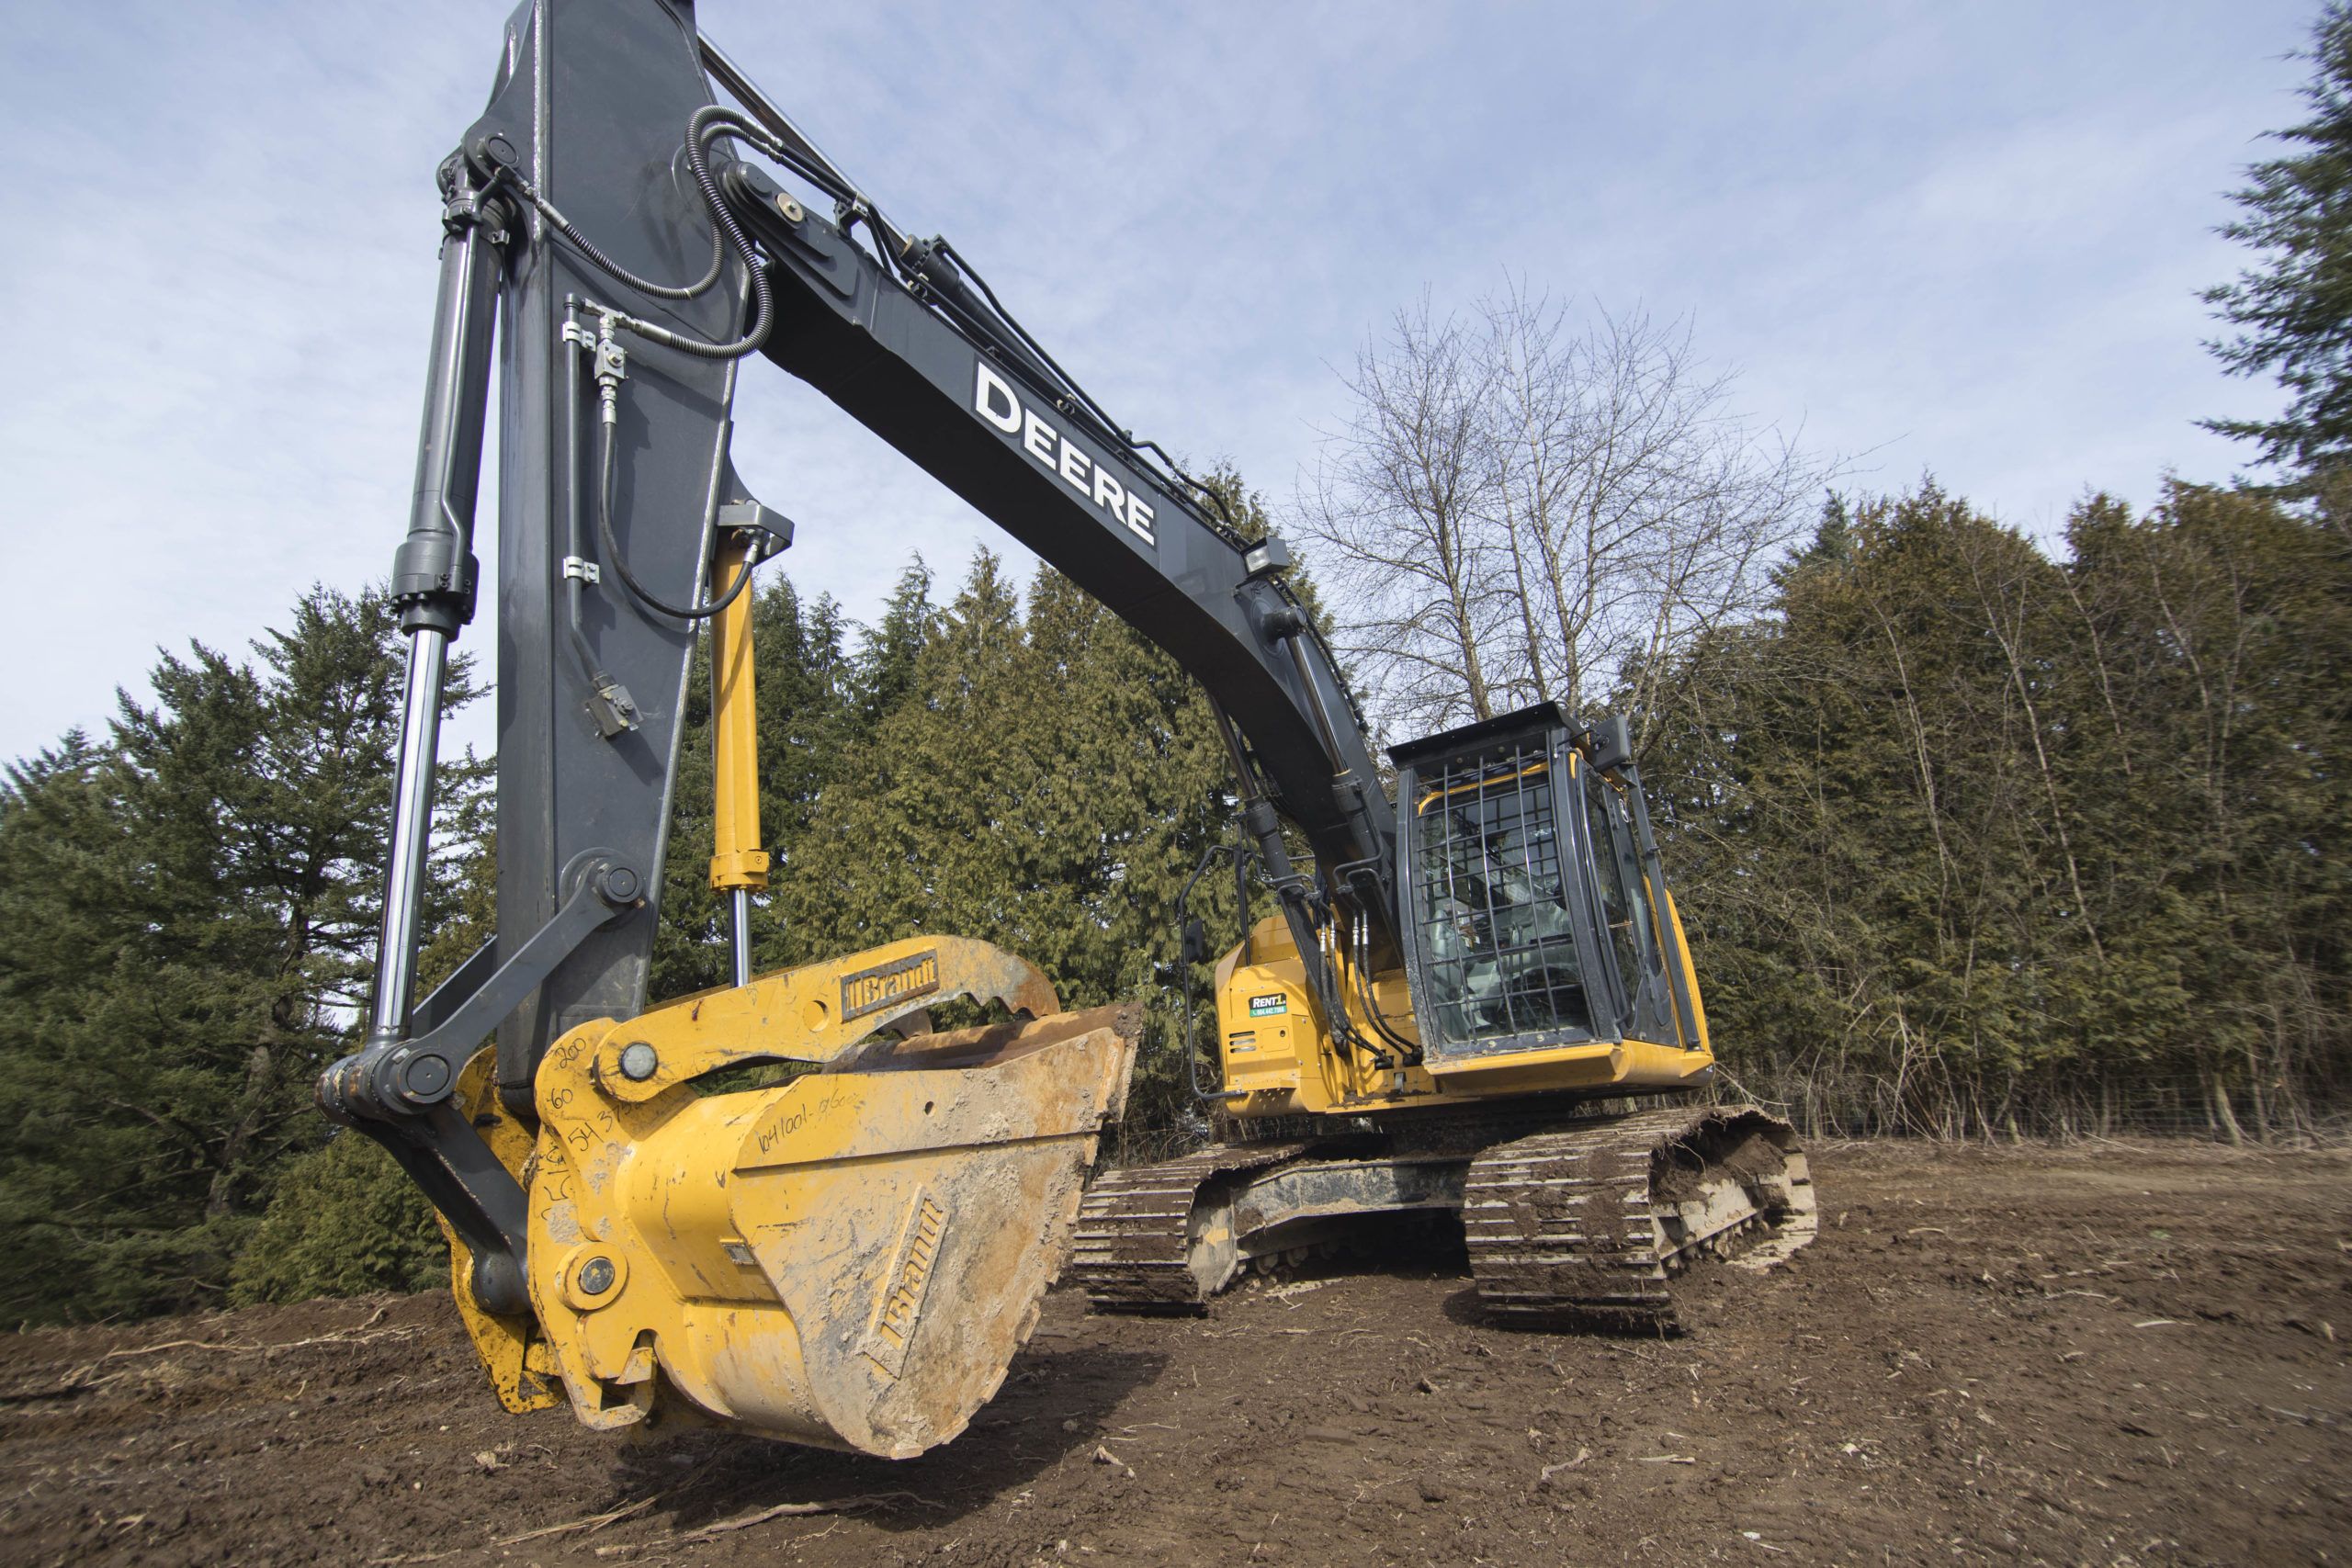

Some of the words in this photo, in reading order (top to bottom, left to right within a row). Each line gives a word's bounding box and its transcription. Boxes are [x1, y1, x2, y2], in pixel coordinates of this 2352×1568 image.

[976, 361, 1155, 546] DEERE
[863, 956, 935, 1006] Brandt
[554, 1037, 586, 1069] 200
[550, 1088, 574, 1110] 60
[568, 1122, 604, 1152] 54
